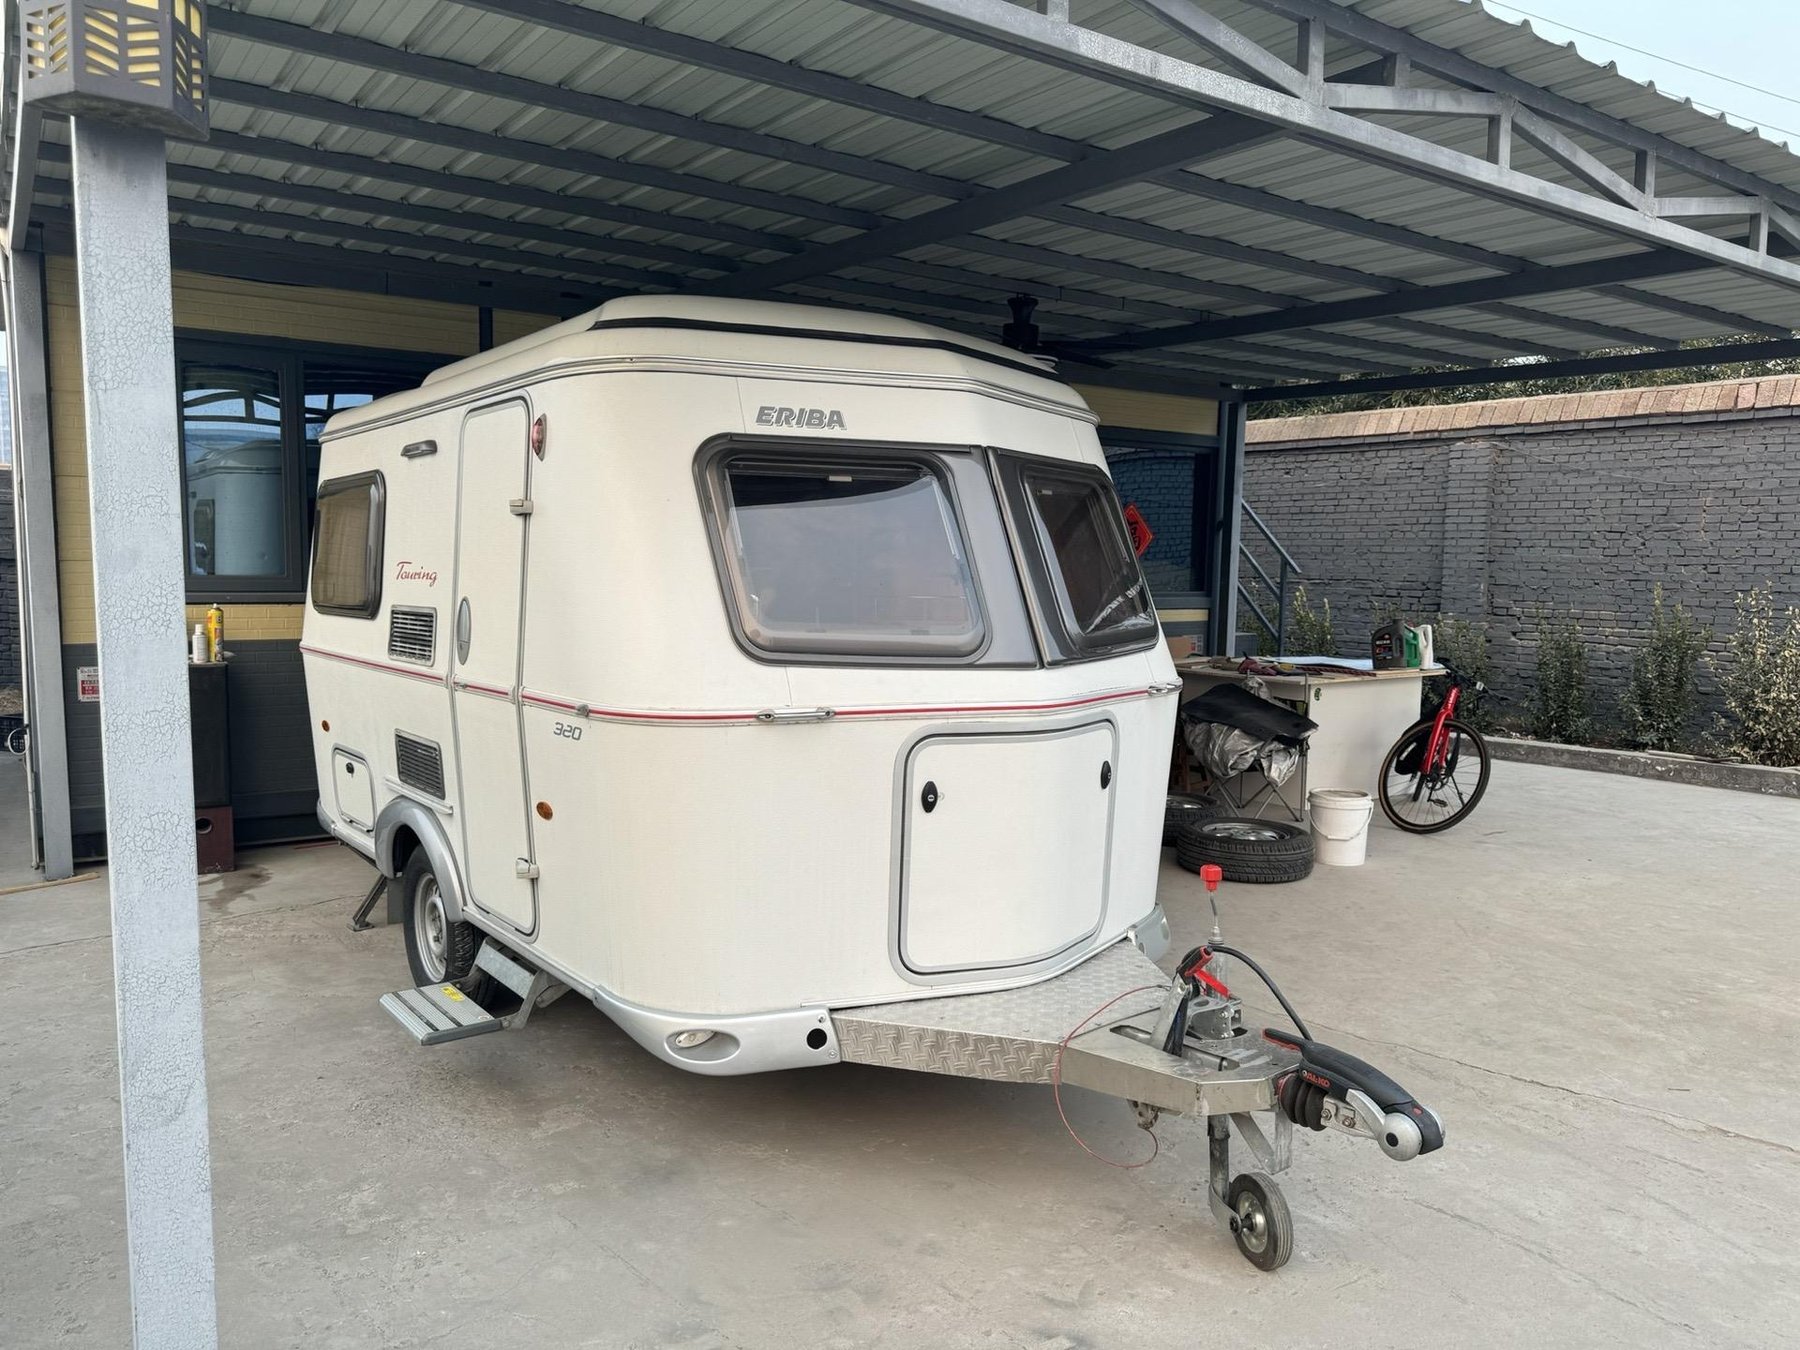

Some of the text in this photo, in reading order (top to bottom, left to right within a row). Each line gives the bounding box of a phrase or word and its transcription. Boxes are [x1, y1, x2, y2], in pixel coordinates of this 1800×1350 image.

[755, 405, 847, 431] ERIBA
[396, 561, 438, 588] Touring
[553, 721, 583, 741] 320
